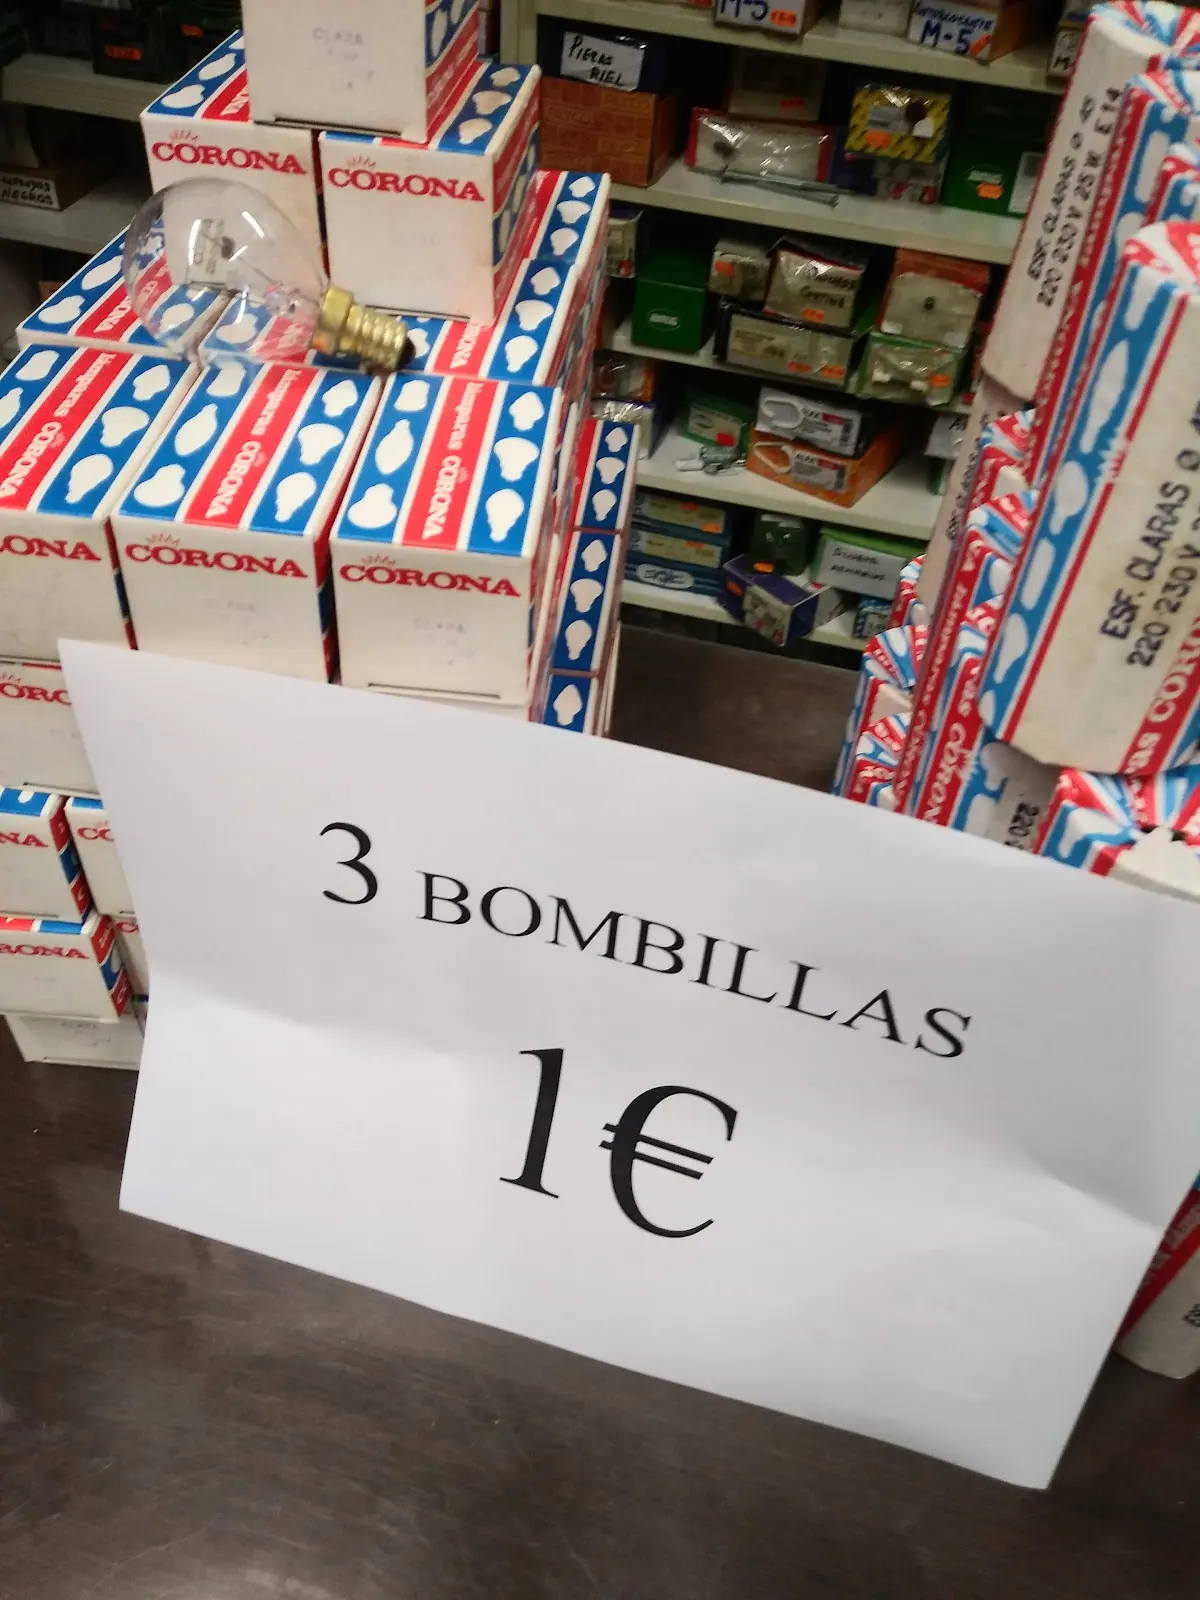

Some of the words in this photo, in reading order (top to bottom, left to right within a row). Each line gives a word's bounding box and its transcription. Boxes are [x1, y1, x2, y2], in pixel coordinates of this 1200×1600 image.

[151, 142, 307, 175] CORONA
[328, 167, 487, 202] CORONA
[205, 440, 261, 520] CORONA
[421, 454, 464, 541] CORONA
[1125, 480, 1191, 583] CLARAS
[124, 543, 309, 580] CORONA
[338, 564, 522, 598] CORONA
[1126, 620, 1171, 668] 220
[319, 822, 378, 905] 3
[420, 870, 971, 1058] BOMBILLAS
